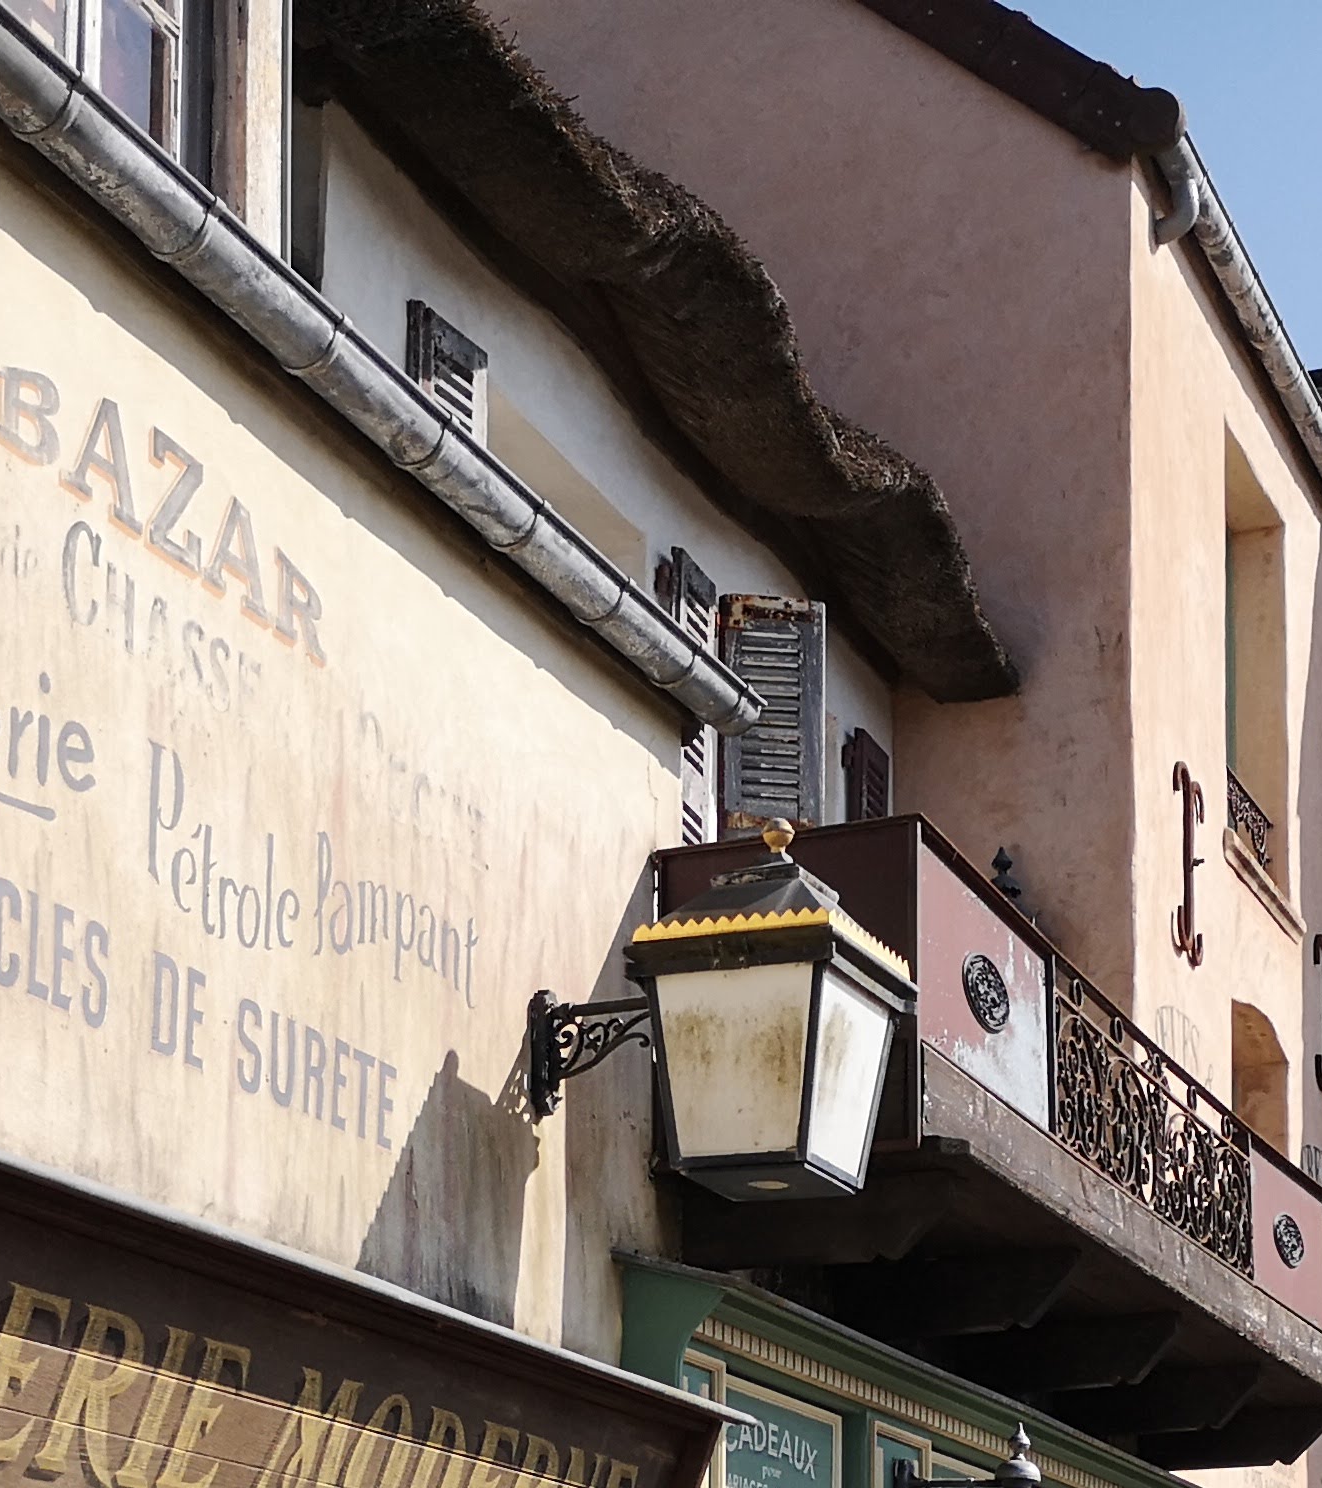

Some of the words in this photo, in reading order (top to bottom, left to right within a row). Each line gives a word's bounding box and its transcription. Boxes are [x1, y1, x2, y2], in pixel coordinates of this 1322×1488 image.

[147, 739, 300, 951] Pétrole
[151, 951, 206, 1074] DE
[236, 998, 397, 1151] SURETE
[726, 1420, 818, 1480] CADEAUX
